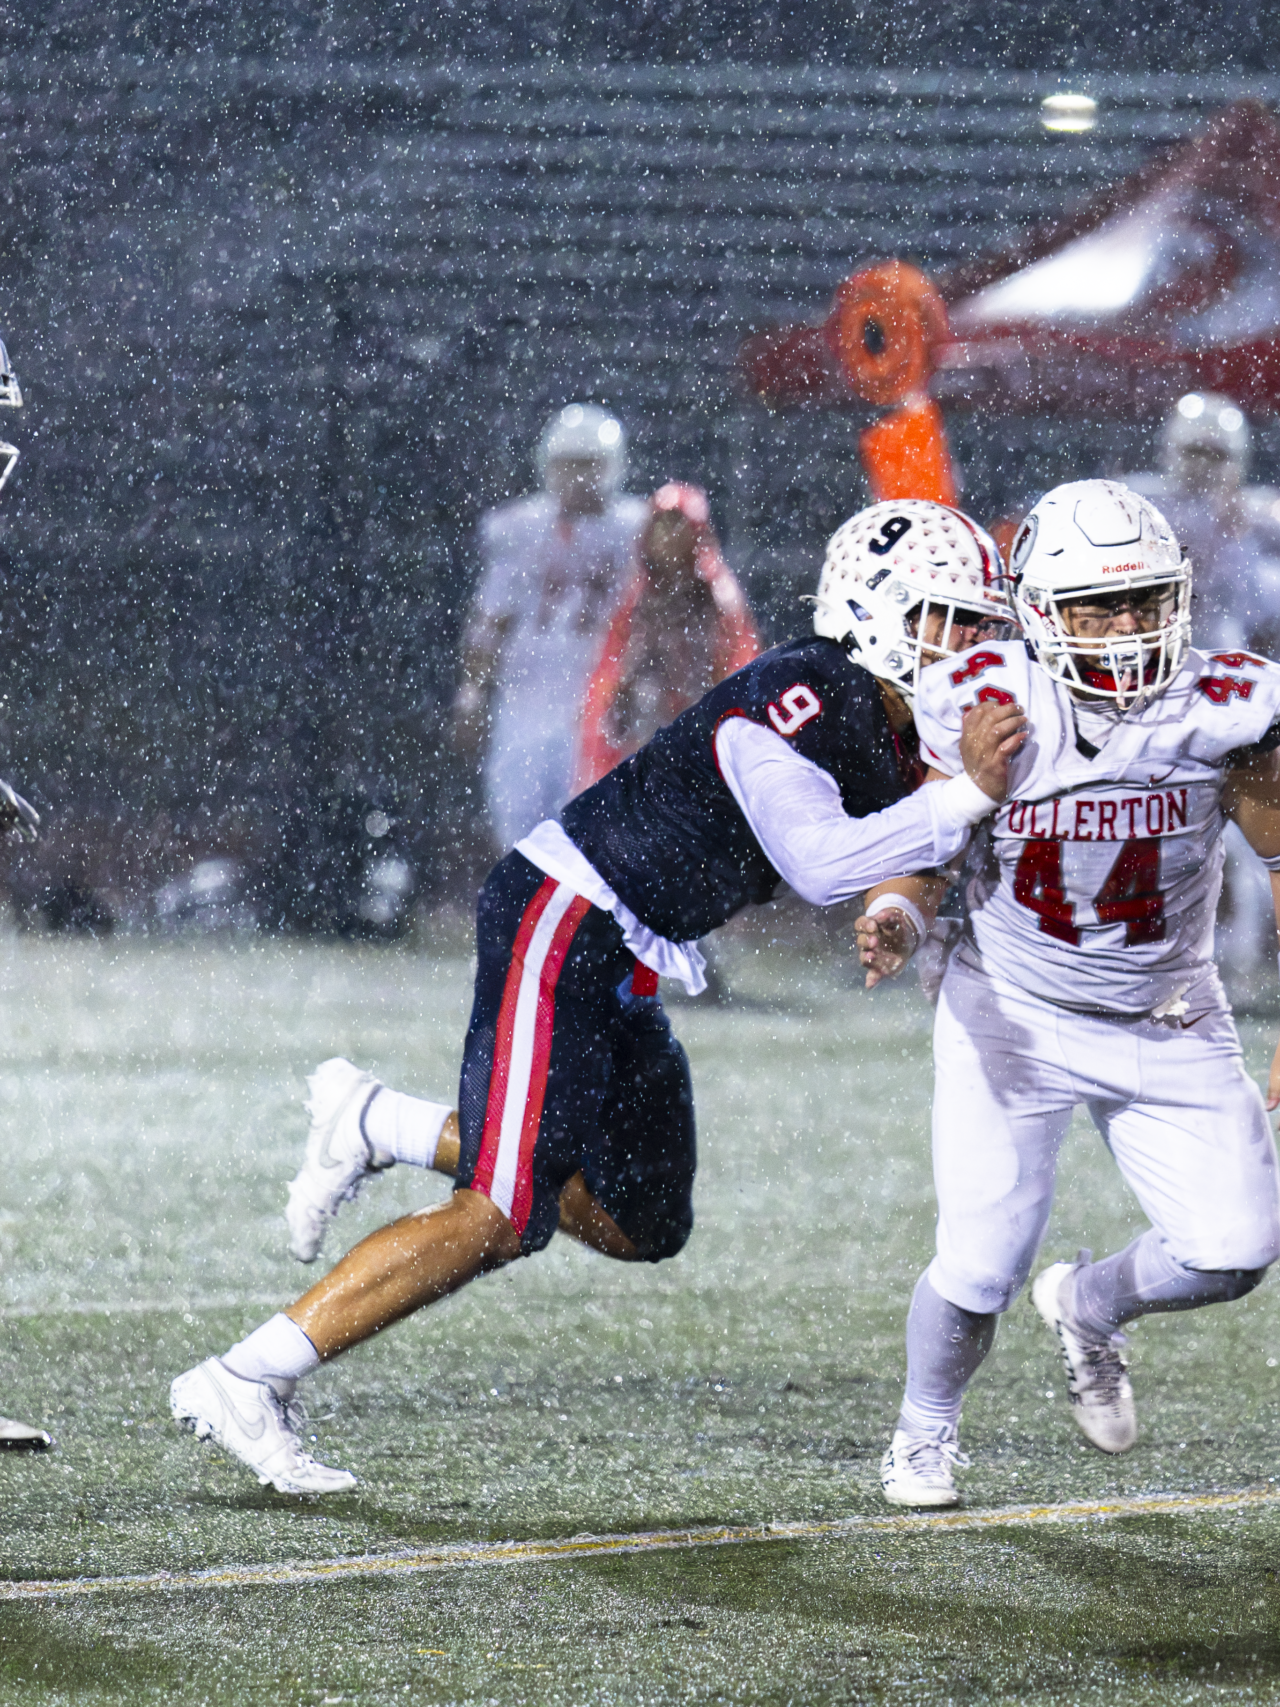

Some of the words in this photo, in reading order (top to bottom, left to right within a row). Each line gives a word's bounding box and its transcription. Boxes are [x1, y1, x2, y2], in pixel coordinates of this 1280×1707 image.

[868, 516, 912, 556] 9
[1102, 561, 1145, 574] Riddell
[766, 682, 823, 737] 9
[1008, 788, 1188, 842] ULLERTON
[1013, 839, 1169, 948] 44
